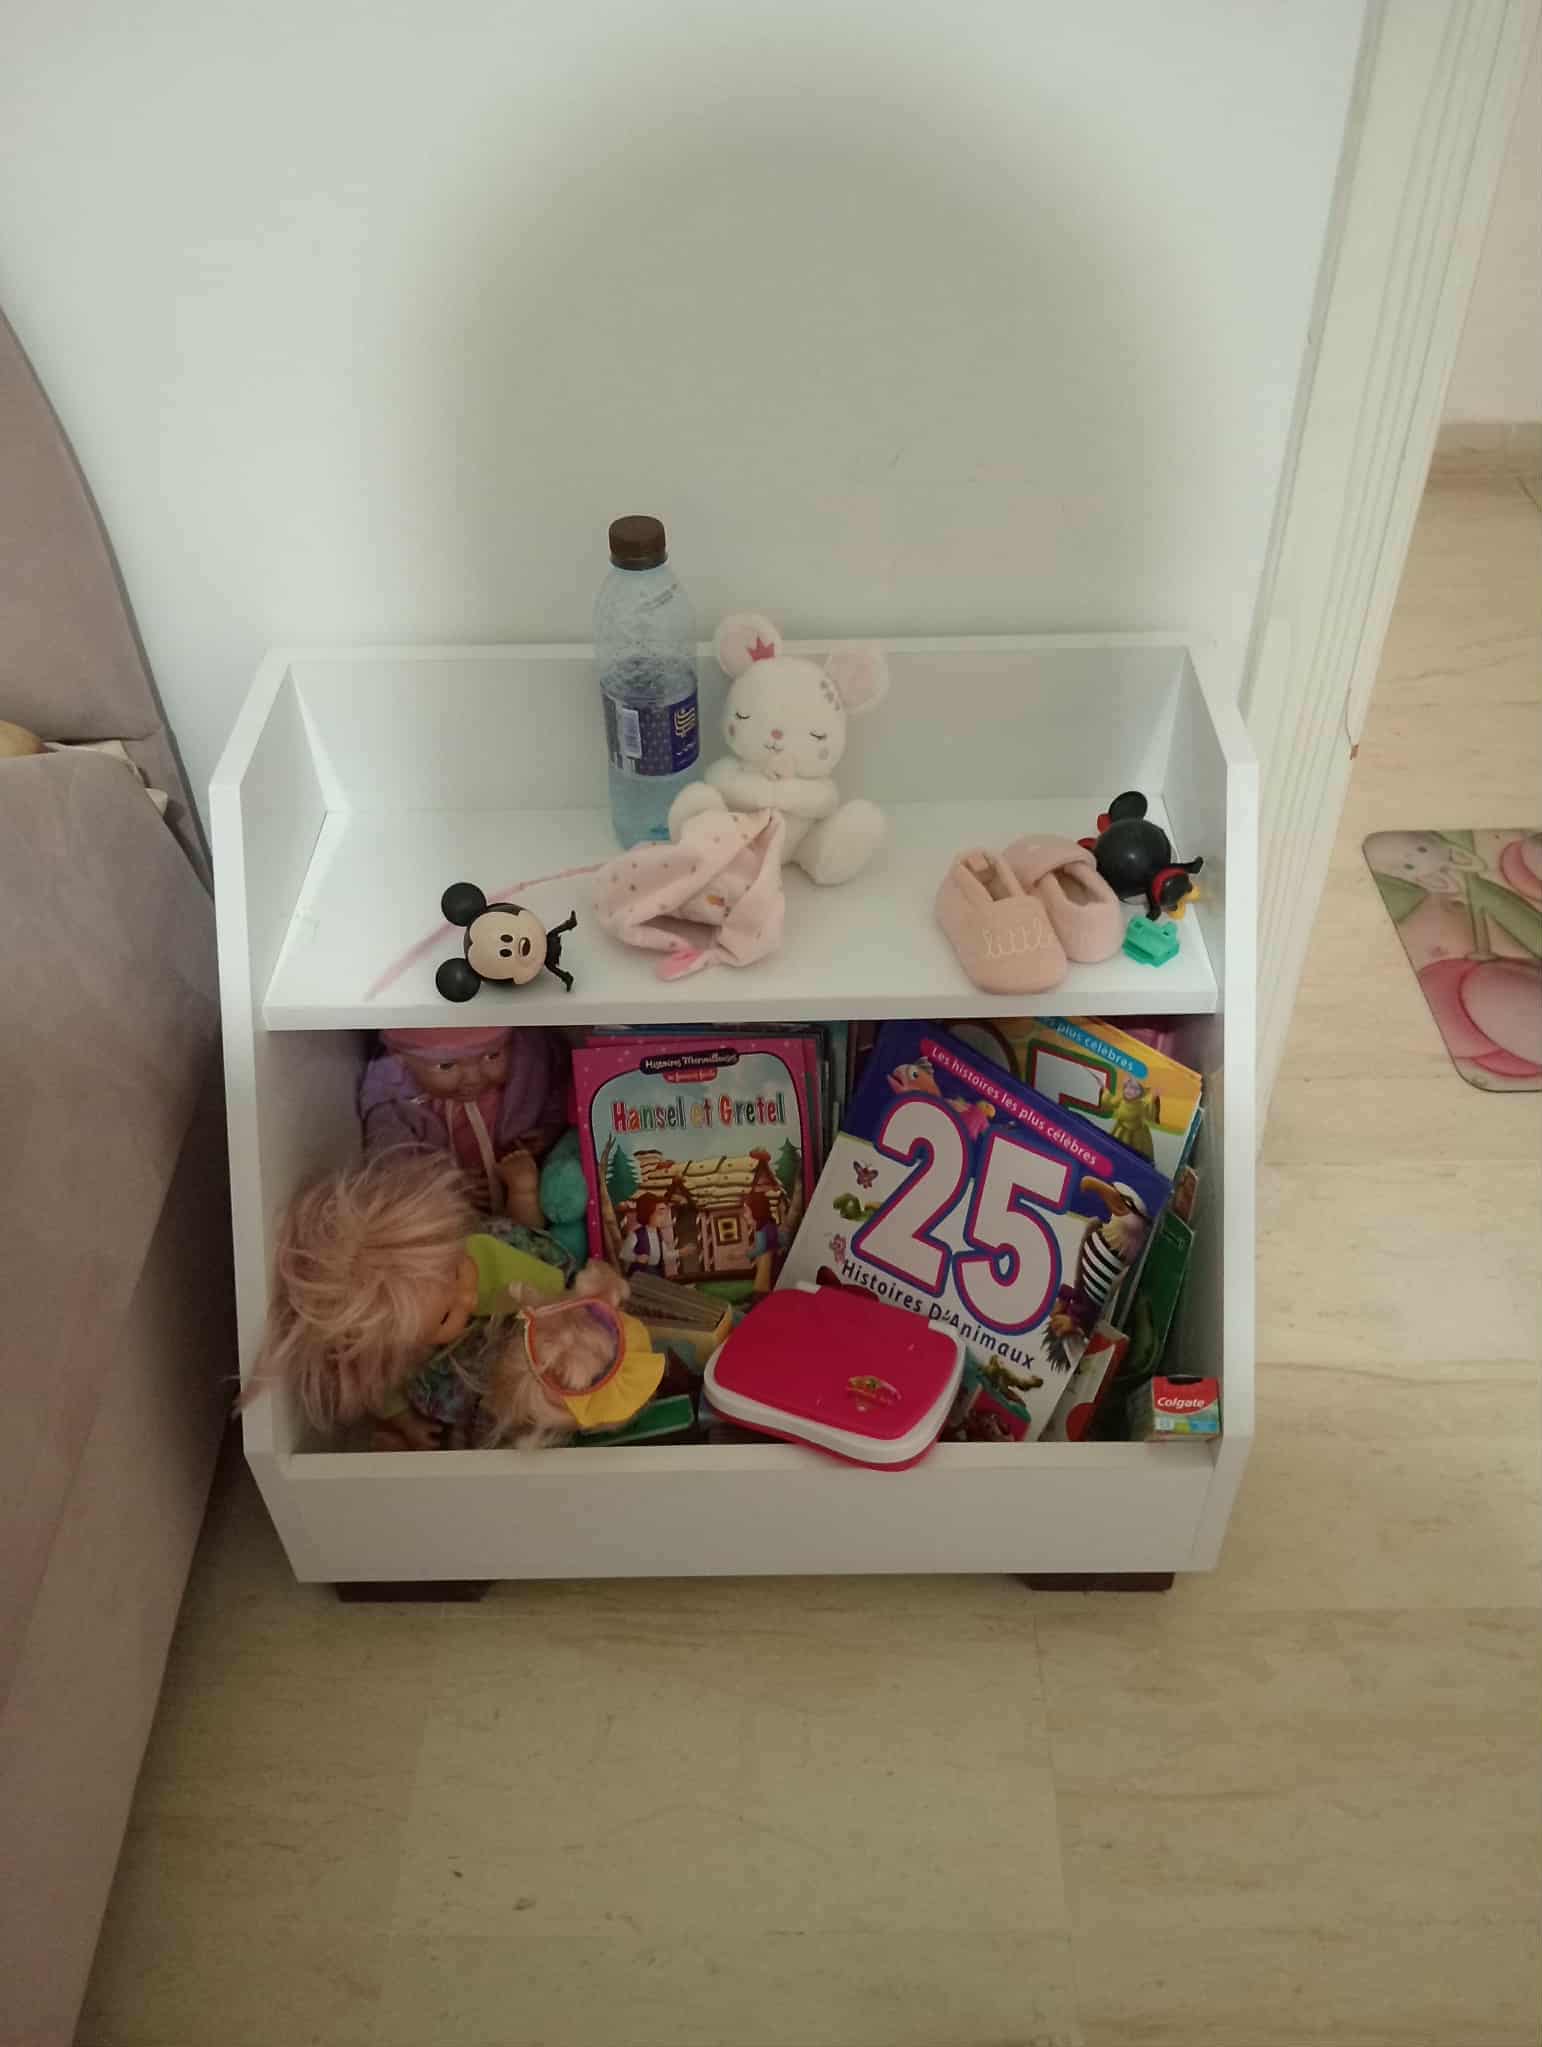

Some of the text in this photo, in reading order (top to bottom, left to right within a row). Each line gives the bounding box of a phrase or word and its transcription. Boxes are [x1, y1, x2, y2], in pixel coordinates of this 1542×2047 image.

[611, 1092, 786, 1134] Hansel et Gretel
[931, 1047, 950, 1066] Les
[951, 1058, 1001, 1100] histoires
[1001, 1092, 1019, 1112] les
[1018, 1107, 1046, 1131] plus
[851, 1093, 1062, 1336] 25
[841, 1258, 924, 1313] Histoires
[1156, 1396, 1206, 1410] Colgate
